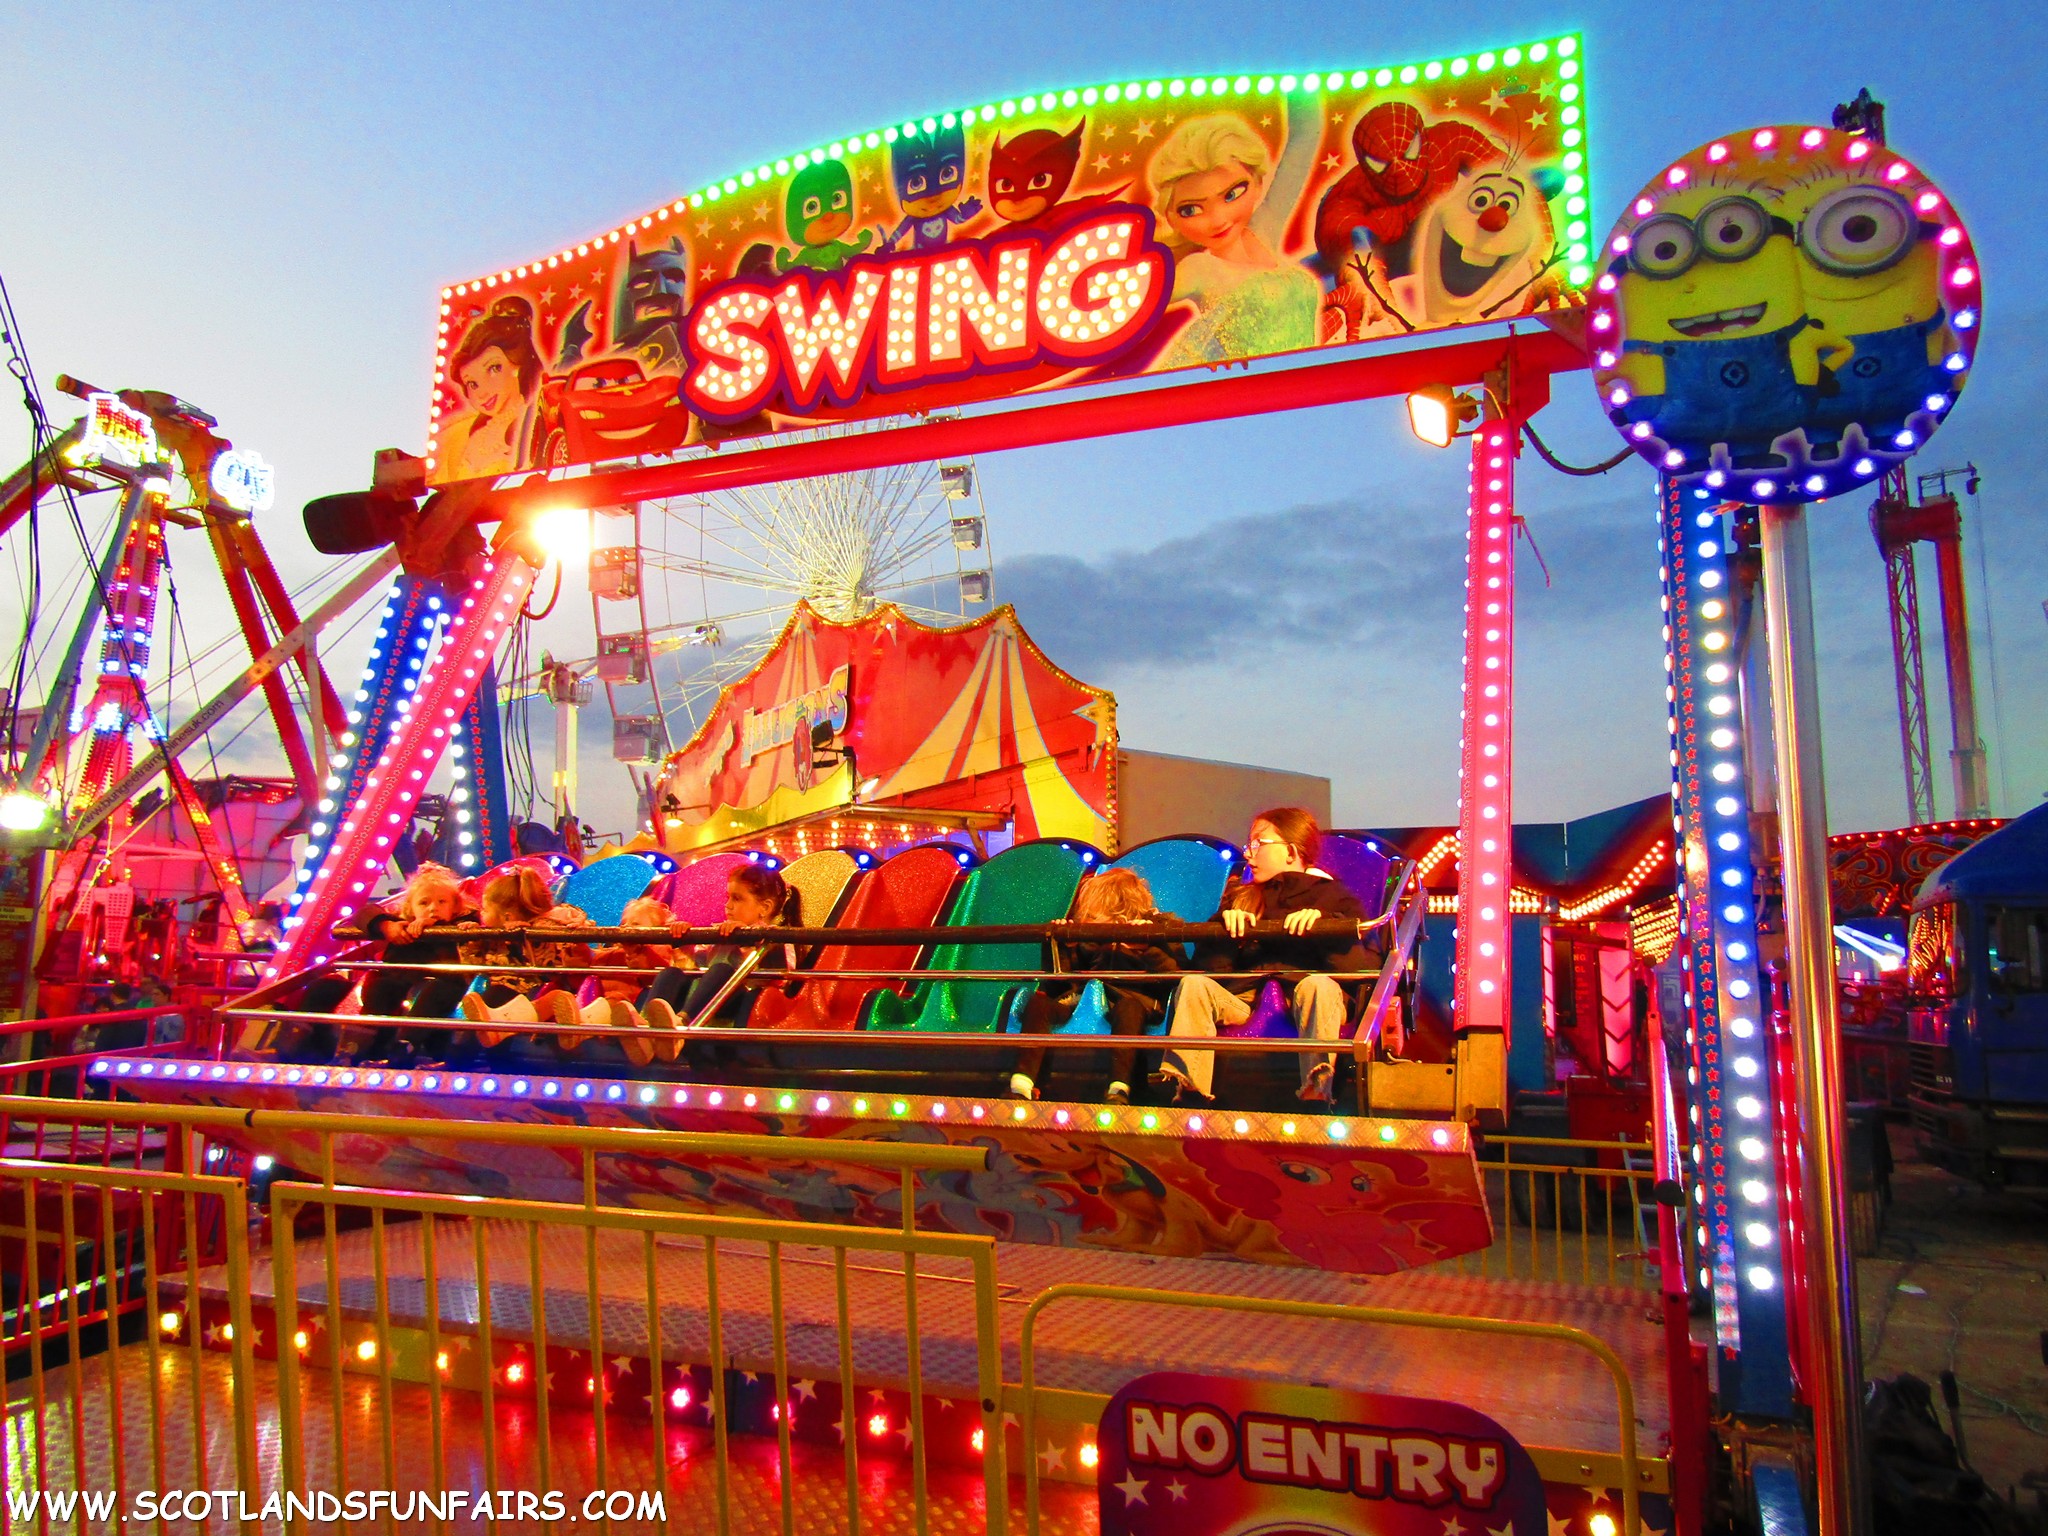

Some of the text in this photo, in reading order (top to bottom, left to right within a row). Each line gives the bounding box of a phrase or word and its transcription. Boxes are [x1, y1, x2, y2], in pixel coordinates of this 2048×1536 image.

[692, 221, 1152, 401] SWING
[740, 663, 849, 769] ILLUSONS
[1129, 1406, 1498, 1501] NO ENTRY
